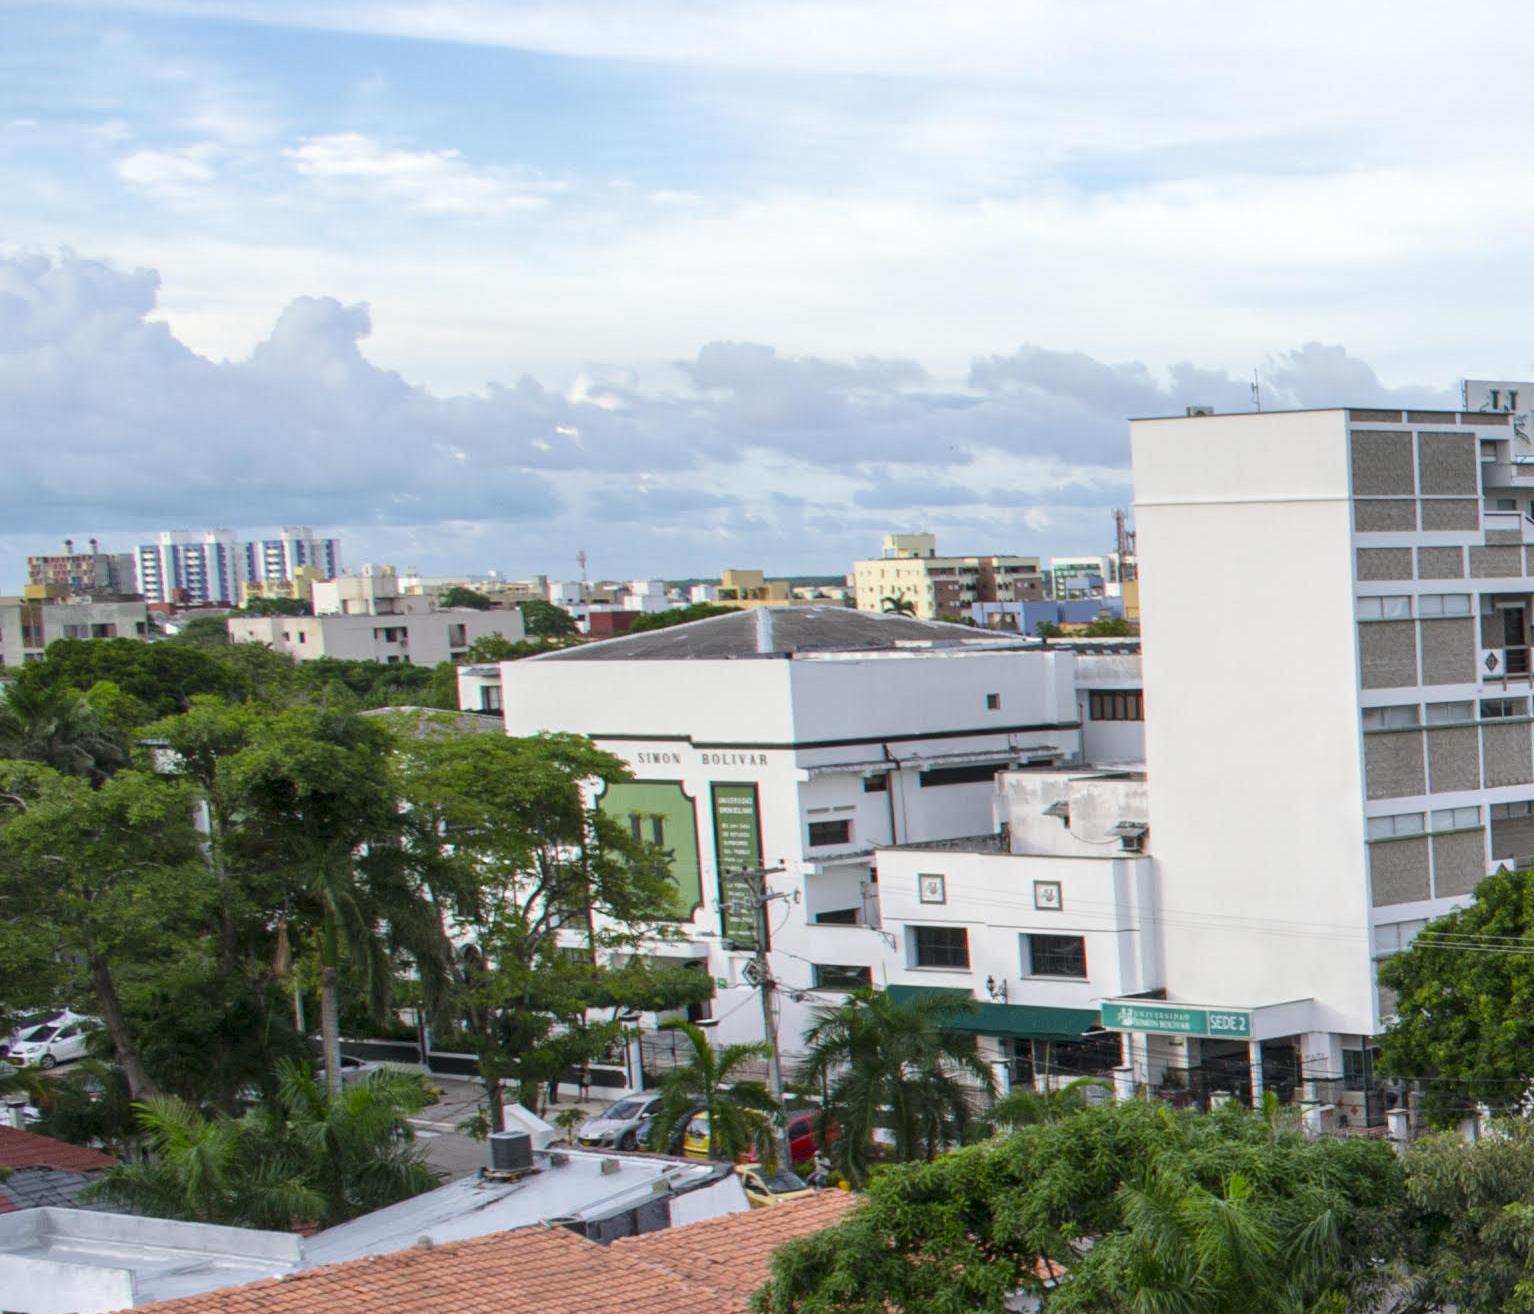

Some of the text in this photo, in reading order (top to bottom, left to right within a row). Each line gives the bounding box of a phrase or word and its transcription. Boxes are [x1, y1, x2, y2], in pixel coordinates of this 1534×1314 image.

[638, 752, 769, 766] SIMON BOLIVAR
[1209, 1015, 1246, 1031] SEDE 2
